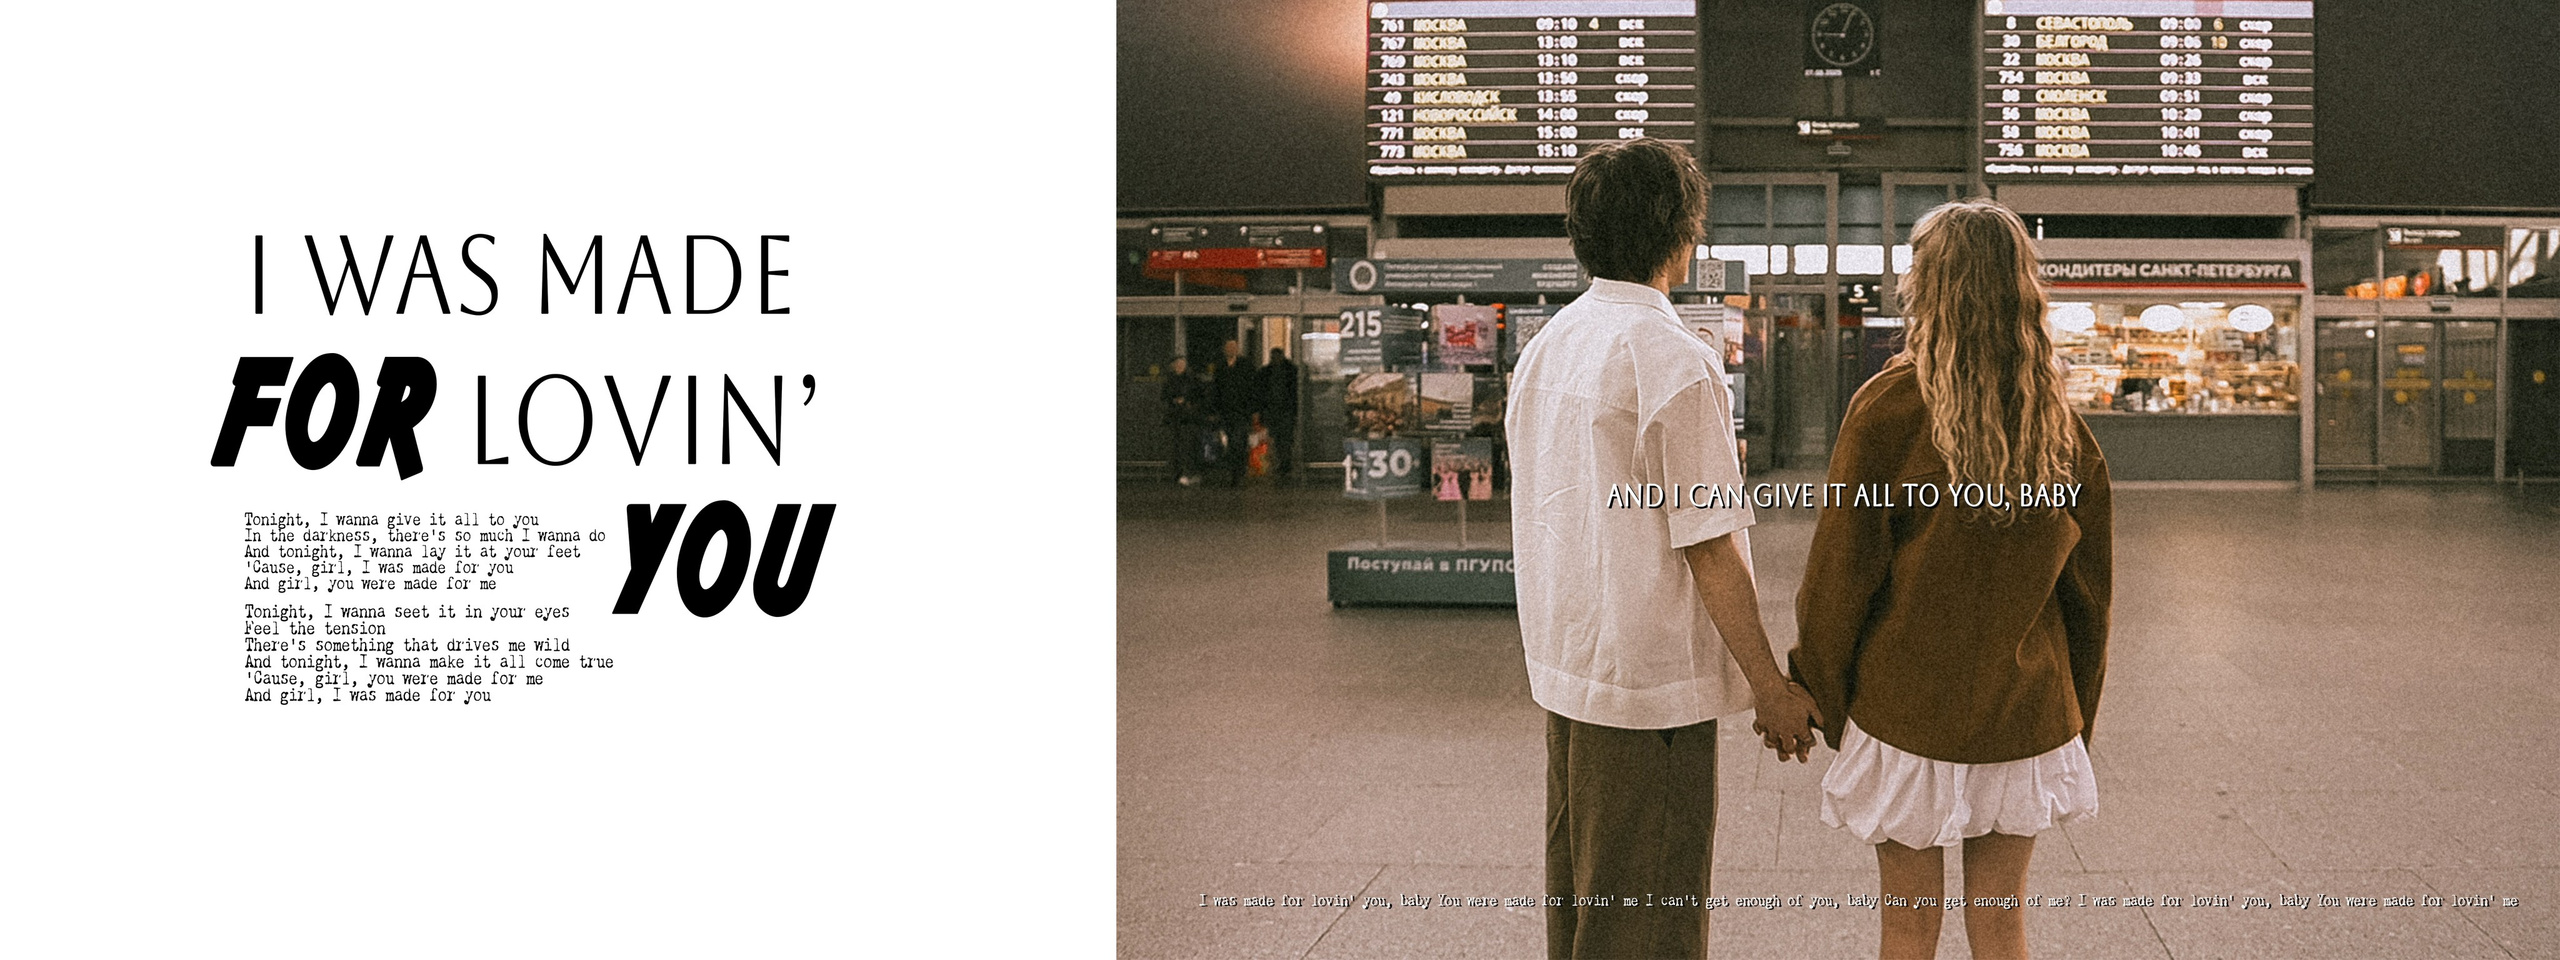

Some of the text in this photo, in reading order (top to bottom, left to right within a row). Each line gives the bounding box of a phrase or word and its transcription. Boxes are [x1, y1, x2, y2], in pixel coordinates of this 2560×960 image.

[2035, 34, 2109, 51] БЕЛГОРОД
[2038, 262, 2293, 280] КОНДИТЕРЫ САНКТ-ПЕТЕРБУРГА
[1340, 310, 1382, 339] 215
[1347, 556, 1434, 573] Поступай
[1439, 561, 1450, 571] в
